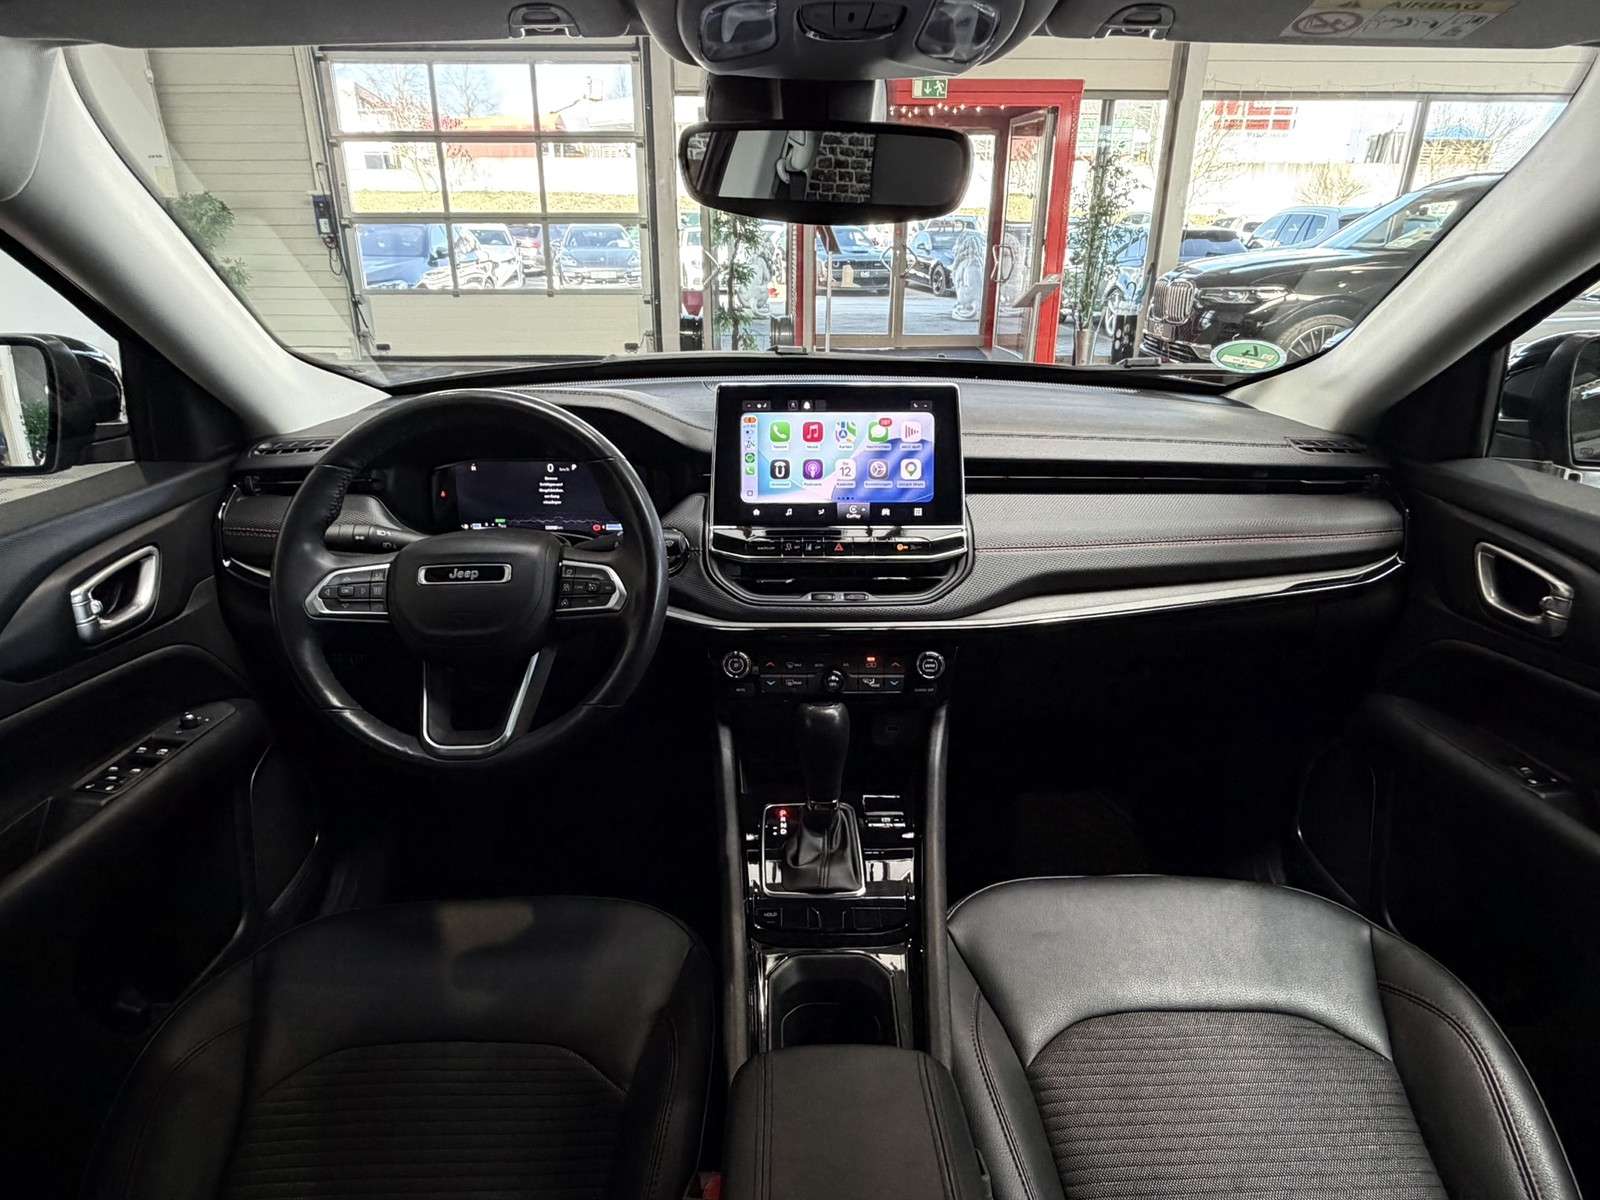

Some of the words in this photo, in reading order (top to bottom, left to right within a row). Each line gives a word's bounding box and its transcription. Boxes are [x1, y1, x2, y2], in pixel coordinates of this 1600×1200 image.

[1387, 0, 1484, 10] AIRBAG
[840, 466, 851, 477] 12
[448, 568, 480, 580] Jeep
